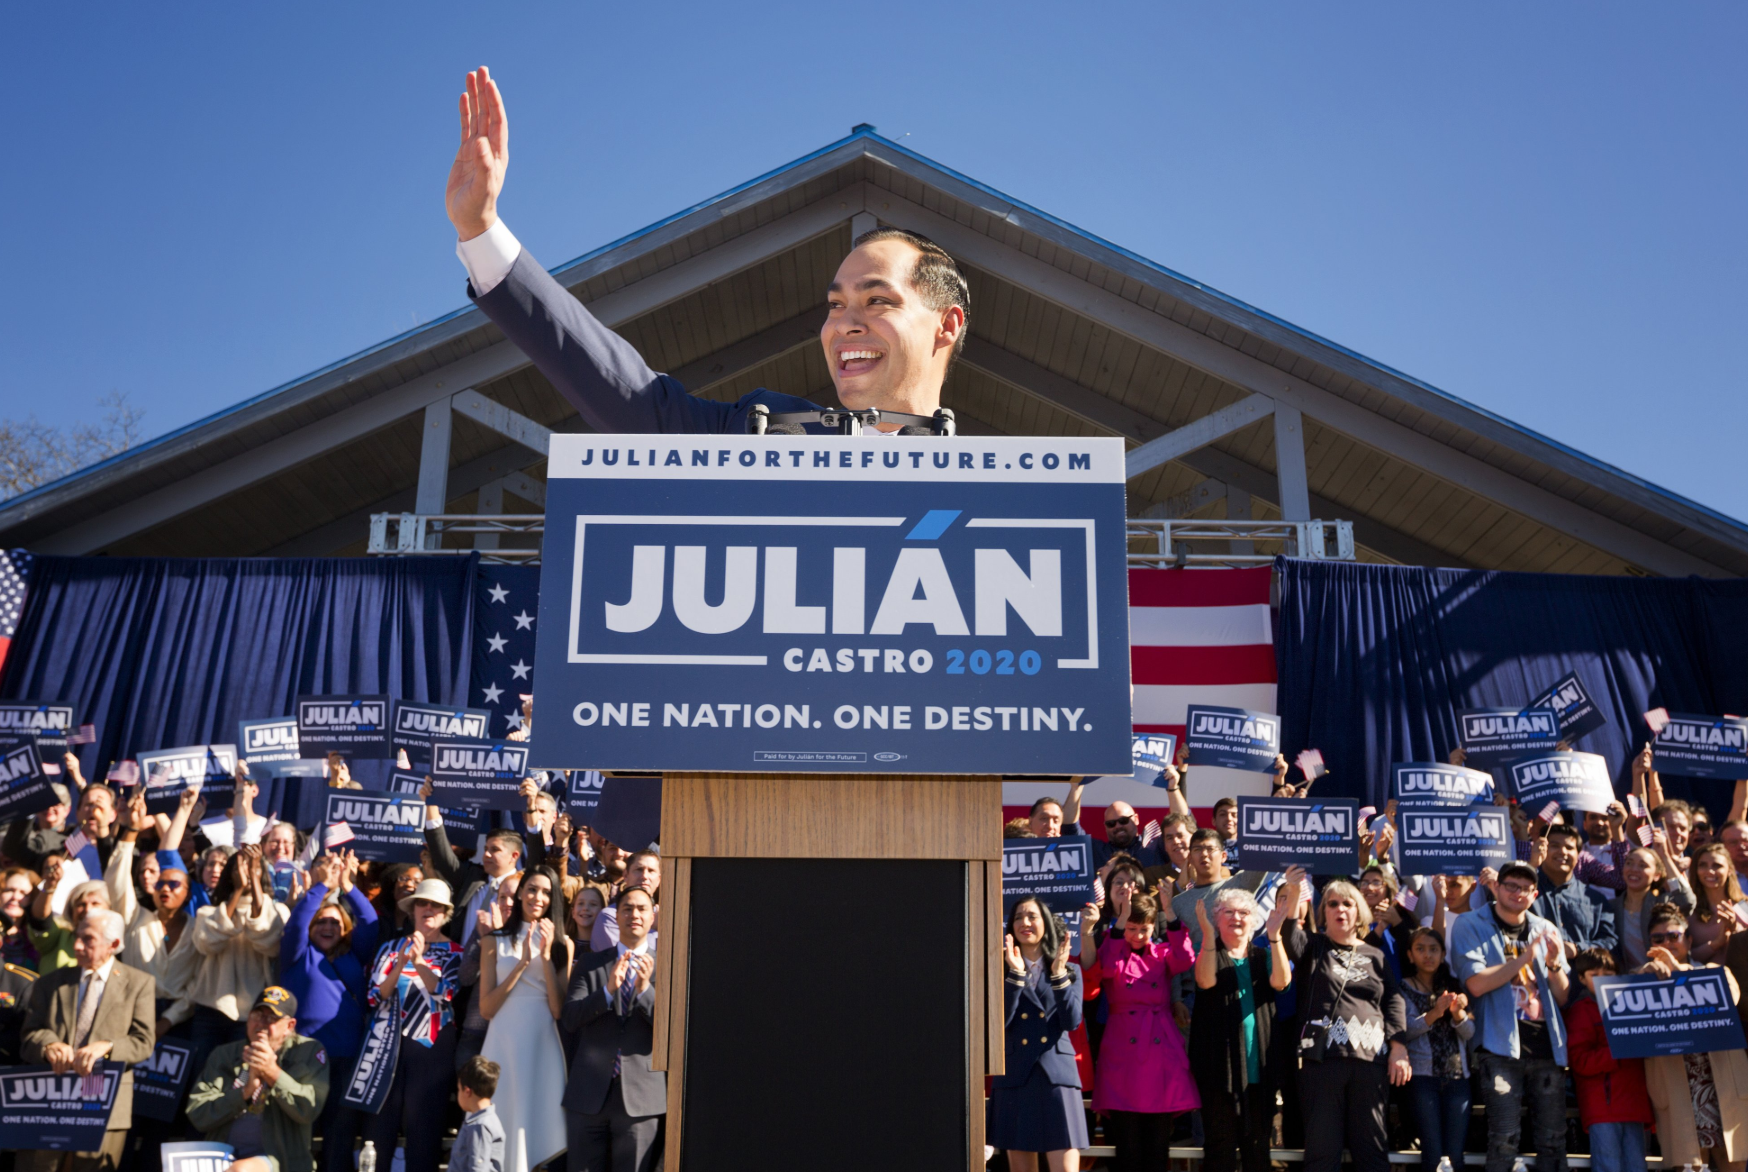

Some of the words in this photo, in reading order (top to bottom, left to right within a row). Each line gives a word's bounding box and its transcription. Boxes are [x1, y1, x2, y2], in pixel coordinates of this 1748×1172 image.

[581, 448, 1092, 471] JULIANFORTHEFUTURE.COM
[605, 510, 1062, 636] JULIÁN
[783, 648, 933, 674] CASTRO
[946, 649, 1041, 676] 2020
[0, 705, 66, 730] ULIÁN
[304, 700, 379, 725] JULIÁN
[572, 702, 650, 728] ONE
[663, 703, 821, 730] NATION.
[833, 705, 911, 731] ONE
[924, 706, 1093, 732] DESTINY.
[402, 712, 480, 737] JULIÁN
[1196, 716, 1271, 741] JULIÁN
[1470, 711, 1549, 736] JULIÁN
[37, 738, 67, 746] DESTINY
[251, 726, 299, 747] JULI
[1225, 735, 1250, 744] CASTRO
[1661, 722, 1741, 747] JULIÁN
[408, 740, 431, 748] NATIO
[1203, 743, 1231, 752] NATION.
[1232, 746, 1246, 754] ONE
[1247, 748, 1277, 759] DESTINY.
[1481, 744, 1510, 752] NATION.
[1527, 741, 1557, 749] DESTINY
[1692, 744, 1719, 752] CASTRO
[161, 751, 231, 779] ULIÁN
[262, 753, 294, 762] NATION.
[438, 745, 521, 771] JULIÁN
[788, 753, 795, 761] by
[1670, 751, 1699, 760] NATION.
[1700, 754, 1715, 762] ONE
[1716, 755, 1748, 765] DESTINY.
[1137, 761, 1165, 772] DESTINY
[491, 783, 520, 791] DESTINY
[1404, 771, 1487, 796] JULIÁN
[1437, 791, 1465, 800] CASTRO
[1521, 794, 1535, 803] ONE
[1535, 787, 1567, 799] NATION.
[332, 798, 421, 826] JULIÁN
[1249, 804, 1345, 833] JULIÁN
[363, 823, 393, 831] CASTRO
[394, 824, 414, 833] 2020
[443, 819, 476, 831] DESTINY.
[1410, 811, 1500, 838] JULIÁN
[392, 836, 424, 845] DESTINY.
[1285, 833, 1318, 841] CASTRO
[1477, 838, 1497, 846] 2020
[1260, 844, 1295, 853] NATION.
[1315, 846, 1353, 854] DESTINY.
[1422, 849, 1456, 857] NATION.
[1456, 849, 1473, 857] ONE
[1474, 850, 1508, 858] DESTINY.
[1002, 843, 1080, 874] ULIÁN
[1023, 873, 1055, 881] CASTRO
[1034, 886, 1052, 894] ONE
[1052, 884, 1090, 893] DESTINY.
[1612, 976, 1719, 1013] JULIÁN
[1654, 1009, 1691, 1019] CASTRO
[1691, 1006, 1716, 1015] 2020
[1611, 1027, 1630, 1036] ONE
[1630, 1024, 1669, 1035] NATION.
[1669, 1023, 1690, 1032] ONE
[1690, 1018, 1735, 1031] DESTINY.
[376, 1026, 390, 1060] CASTRO
[366, 1087, 378, 1105] ONE
[50, 1101, 82, 1110] CASTRO
[2, 1115, 21, 1123] ONE
[22, 1115, 58, 1125] NATION.
[59, 1116, 75, 1125] ONE
[76, 1116, 106, 1126] DESTINY.
